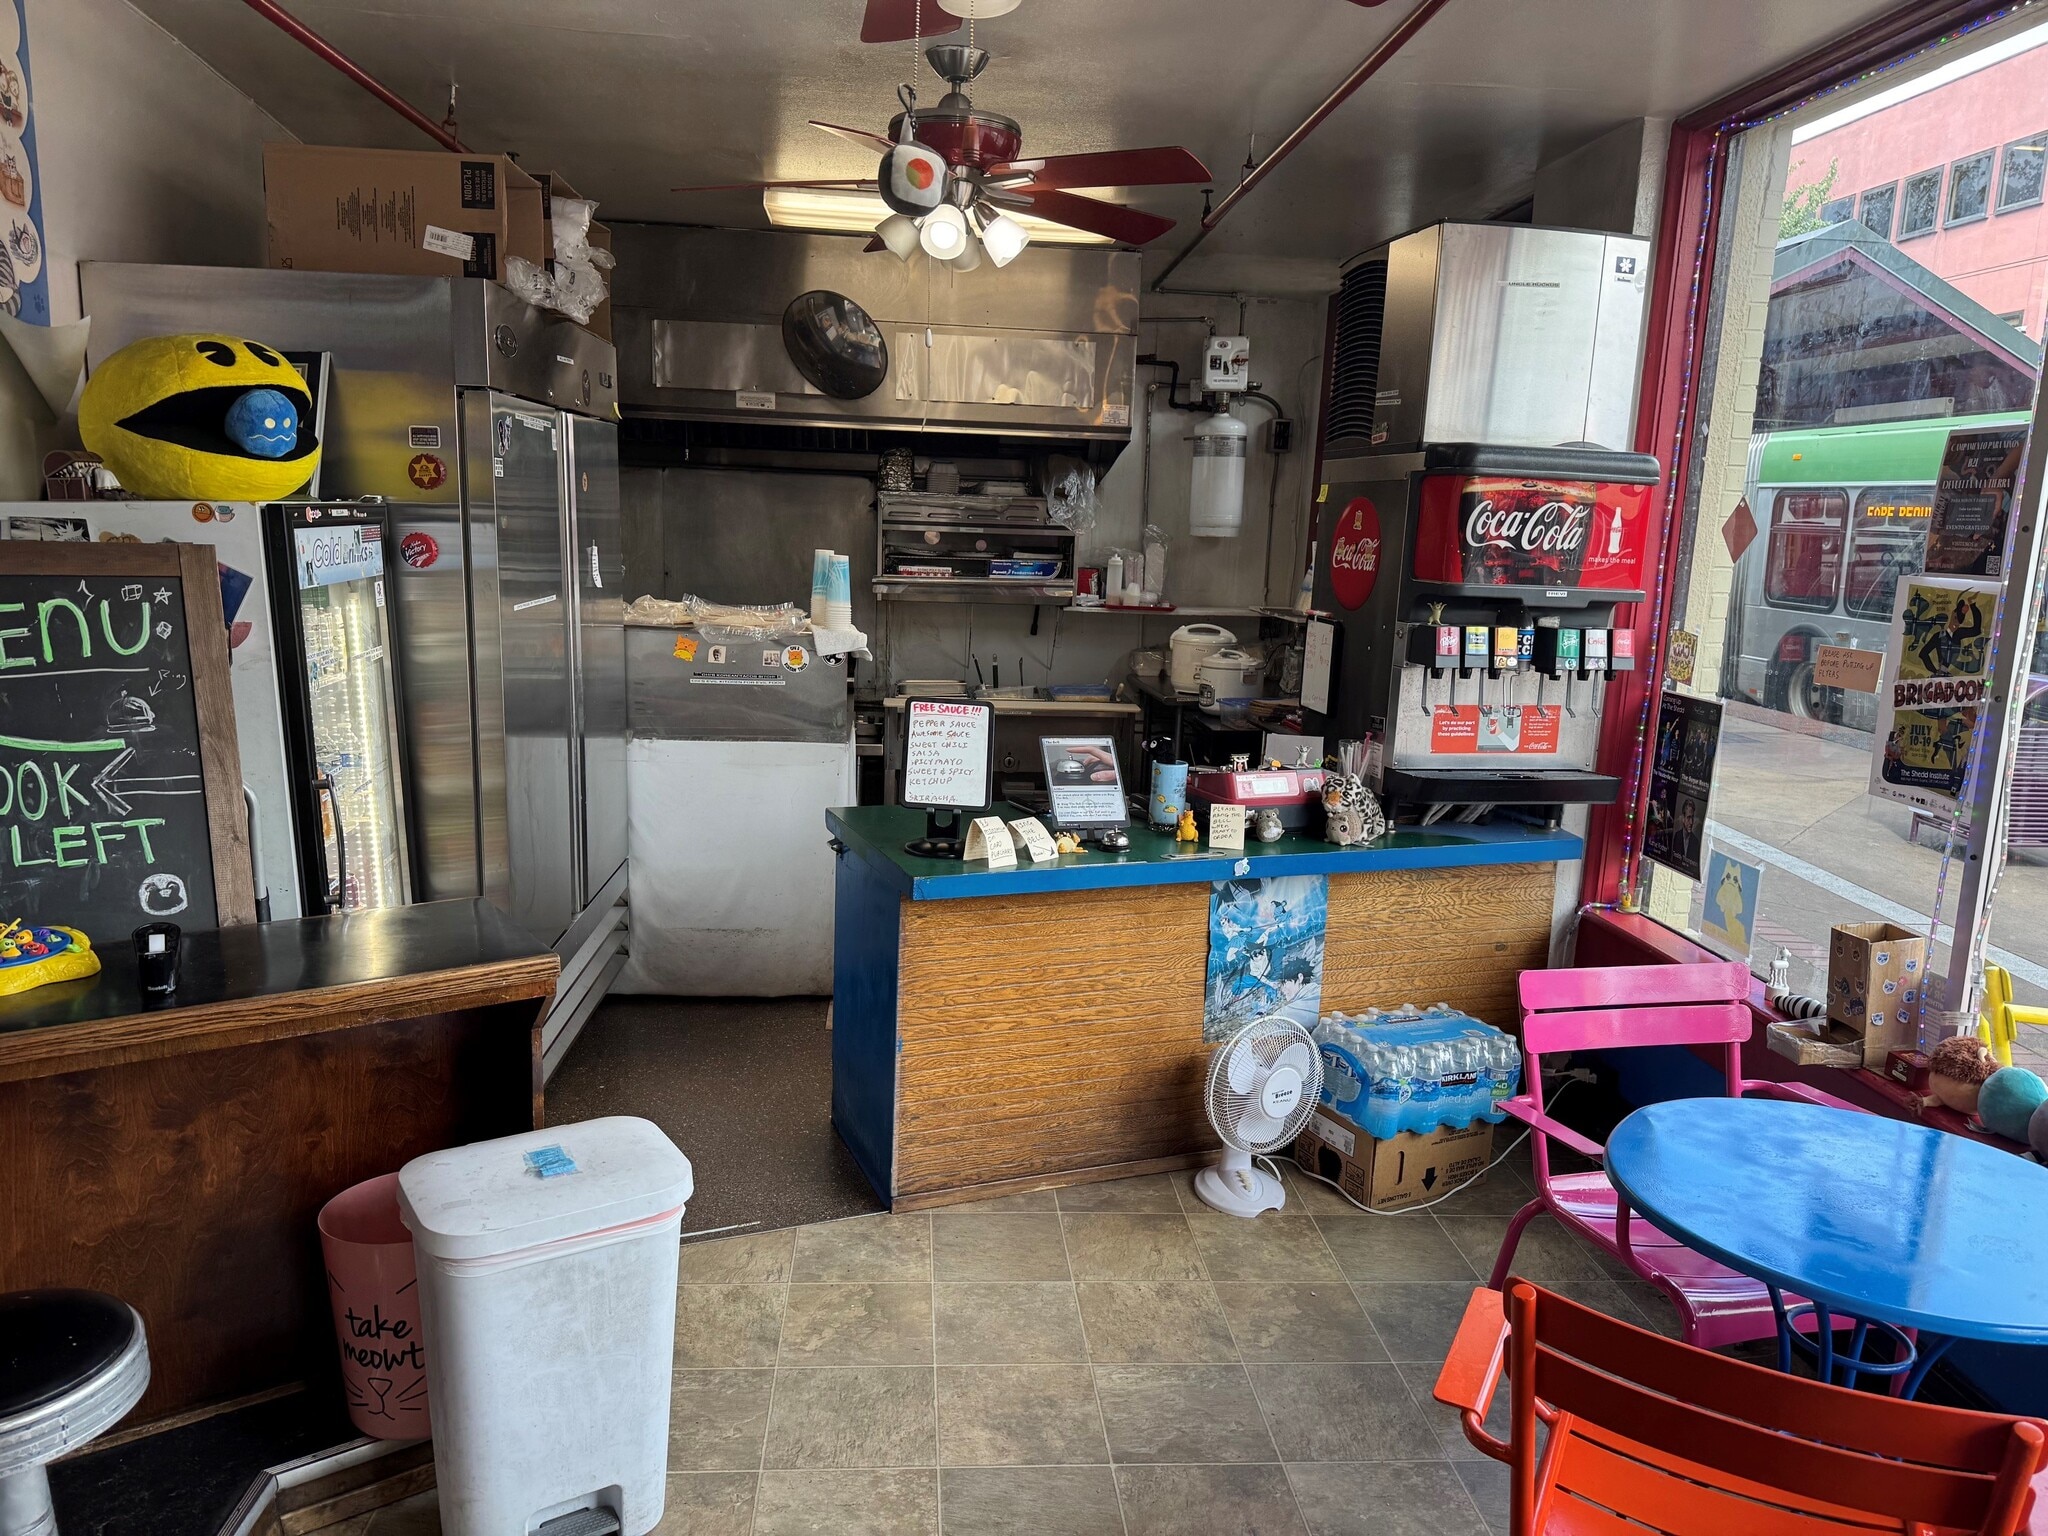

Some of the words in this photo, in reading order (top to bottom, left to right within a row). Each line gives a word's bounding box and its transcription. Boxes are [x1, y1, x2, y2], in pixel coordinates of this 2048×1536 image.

[1466, 500, 1590, 550] Coca-Cola
[314, 537, 342, 569] Cold
[405, 543, 427, 556] Victory
[1609, 555, 1620, 563] the
[1820, 660, 1840, 668] BEFORE
[913, 703, 936, 713] FREE
[937, 704, 982, 716] SAUCE!!!
[913, 720, 945, 728] PEPPER
[949, 720, 977, 729] SAUCE
[1910, 724, 1933, 735] JULY
[946, 730, 971, 739] SAUCE
[910, 741, 937, 749] SWEET
[1909, 735, 1932, 747] 10-19
[908, 768, 937, 776] SWEET
[948, 768, 974, 776] SPICY
[1901, 769, 1911, 777] The
[1912, 769, 1929, 779] Shedd
[1929, 771, 1950, 780] Institute
[909, 776, 952, 786] KETCHUP
[10, 818, 166, 868] LEFT
[1027, 833, 1046, 844] BELL
[1275, 1090, 1293, 1099] Breeze
[1448, 1160, 1461, 1168] ALTO
[1387, 1193, 1408, 1202] GALLONS
[345, 1304, 413, 1340] take
[343, 1337, 425, 1371] meowt
